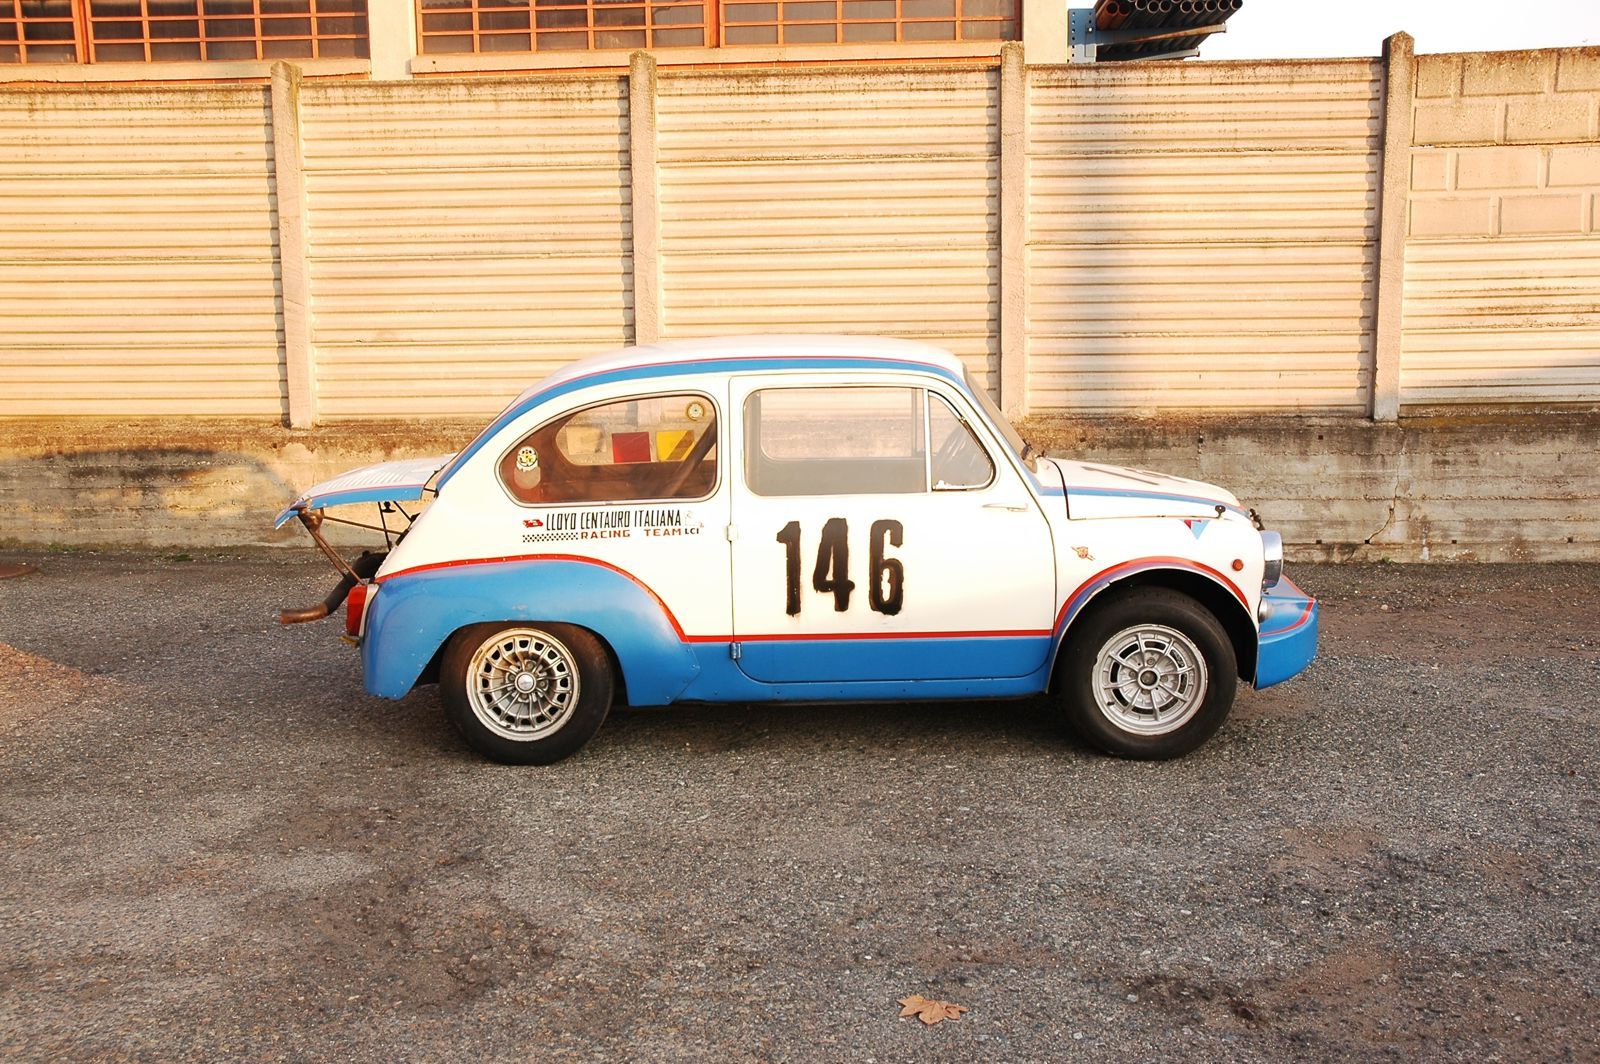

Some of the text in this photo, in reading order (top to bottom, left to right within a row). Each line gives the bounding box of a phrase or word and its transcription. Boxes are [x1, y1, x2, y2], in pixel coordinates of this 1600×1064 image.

[580, 511, 631, 530] CENTAURO
[634, 509, 682, 527] ITALIANA
[580, 528, 682, 540] RACING TEAM
[776, 517, 904, 617] 146
